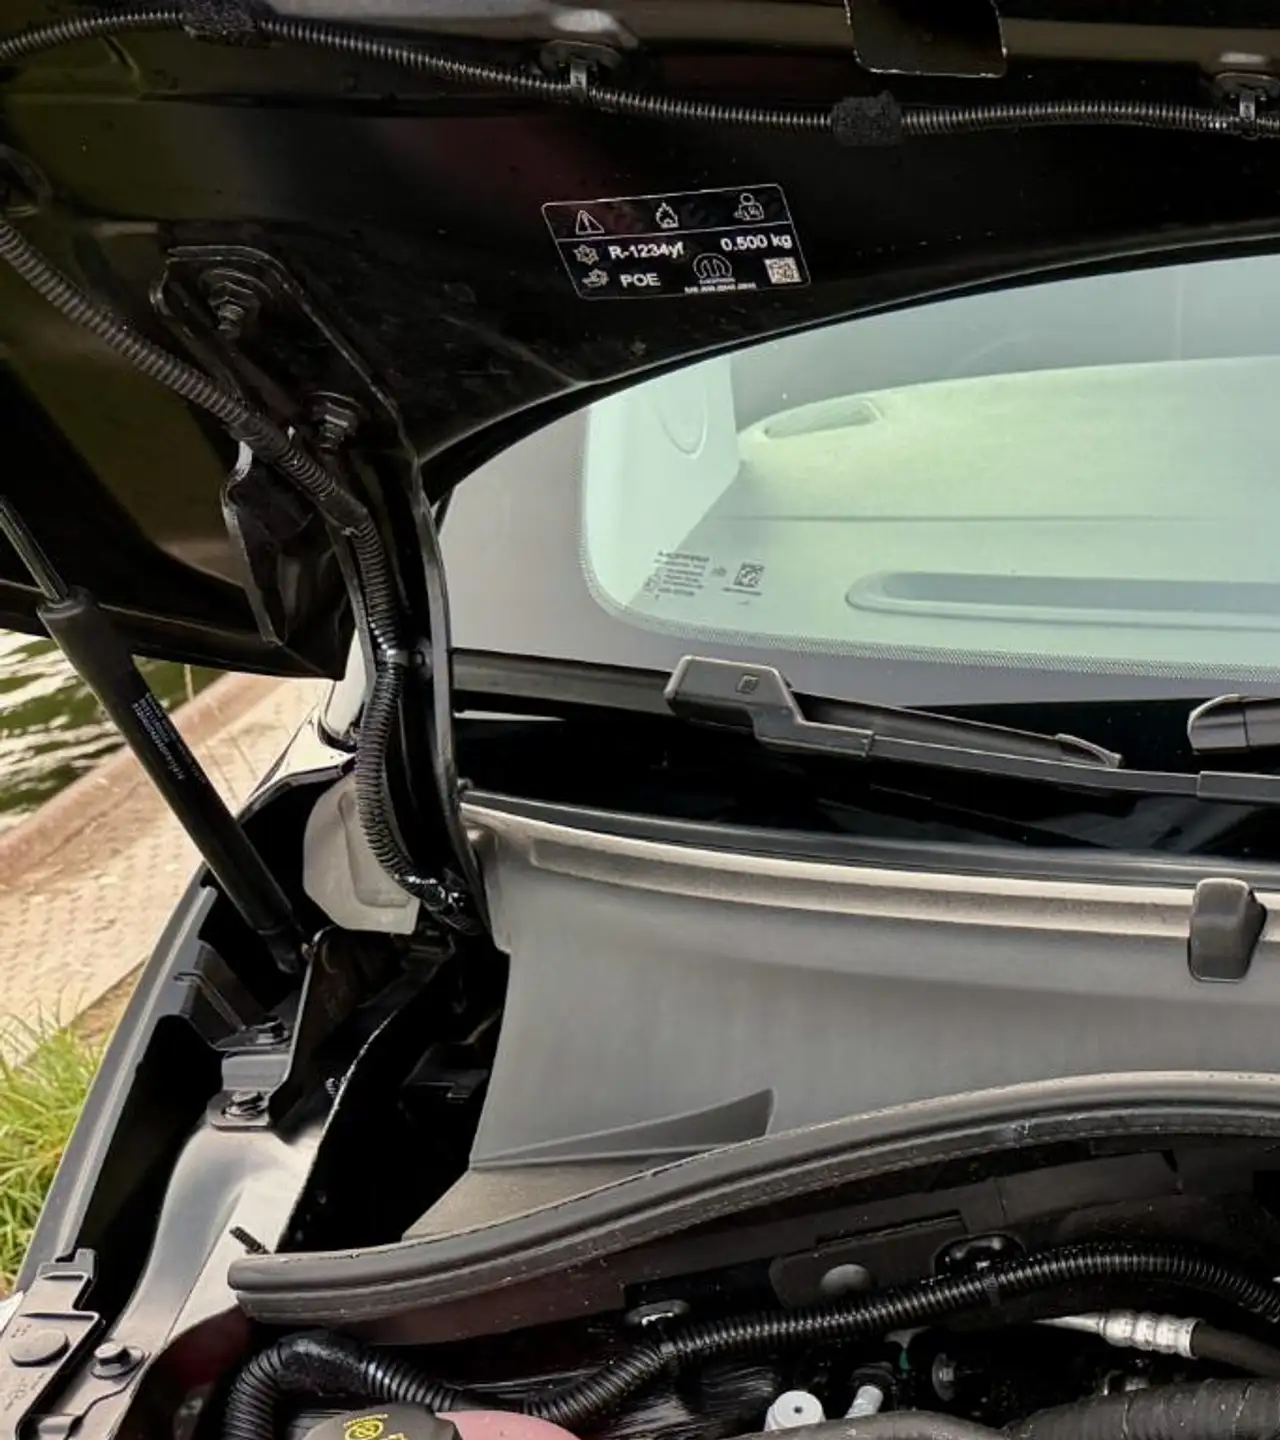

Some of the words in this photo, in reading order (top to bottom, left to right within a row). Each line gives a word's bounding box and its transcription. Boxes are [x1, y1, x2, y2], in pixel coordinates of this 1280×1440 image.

[609, 241, 684, 260] R-1234yf
[720, 234, 768, 252] 0.500
[771, 232, 793, 249] kg
[620, 272, 661, 288] POE
